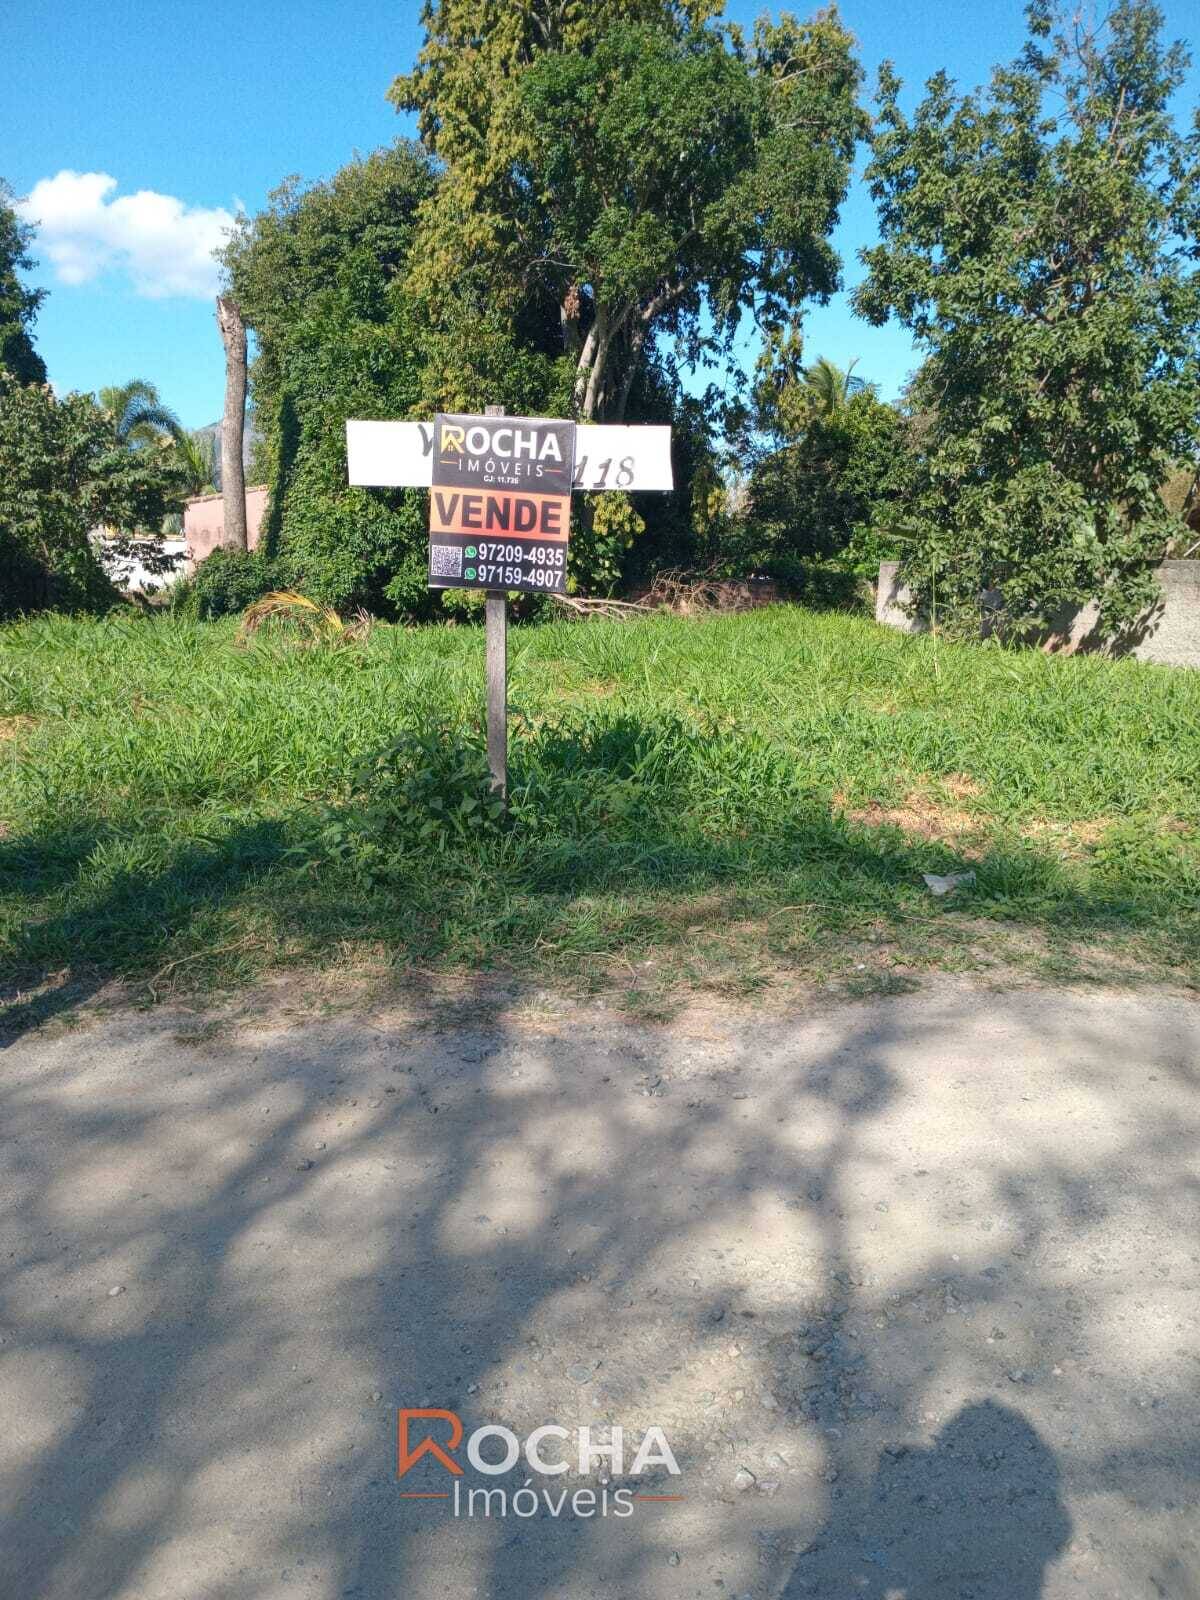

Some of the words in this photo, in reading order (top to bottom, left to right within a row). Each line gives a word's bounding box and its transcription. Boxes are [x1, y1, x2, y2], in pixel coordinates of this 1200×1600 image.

[441, 424, 562, 462] ROCHA
[458, 458, 544, 478] IMÓVEIS
[434, 492, 562, 534] VENDE
[478, 543, 564, 566] 97209-4935
[478, 565, 563, 588] 97159-4907
